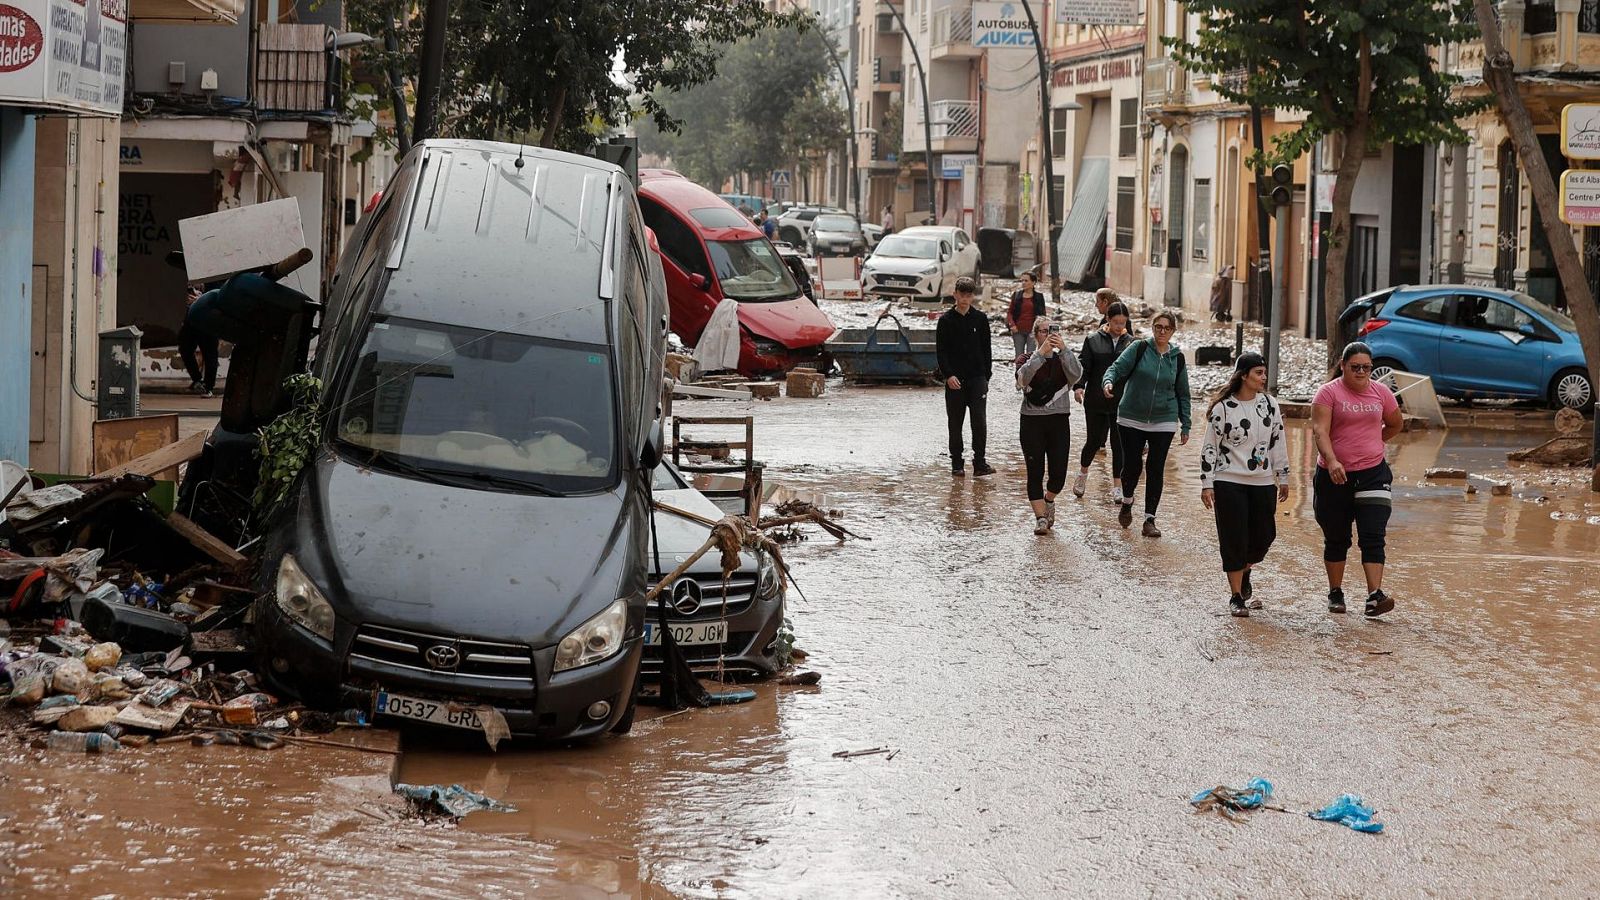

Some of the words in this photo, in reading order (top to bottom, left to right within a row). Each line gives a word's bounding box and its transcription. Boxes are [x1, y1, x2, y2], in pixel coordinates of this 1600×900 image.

[1568, 193, 1594, 201] Centre
[1342, 400, 1381, 413] Relax
[653, 626, 694, 643] 702
[389, 697, 438, 720] 0537
